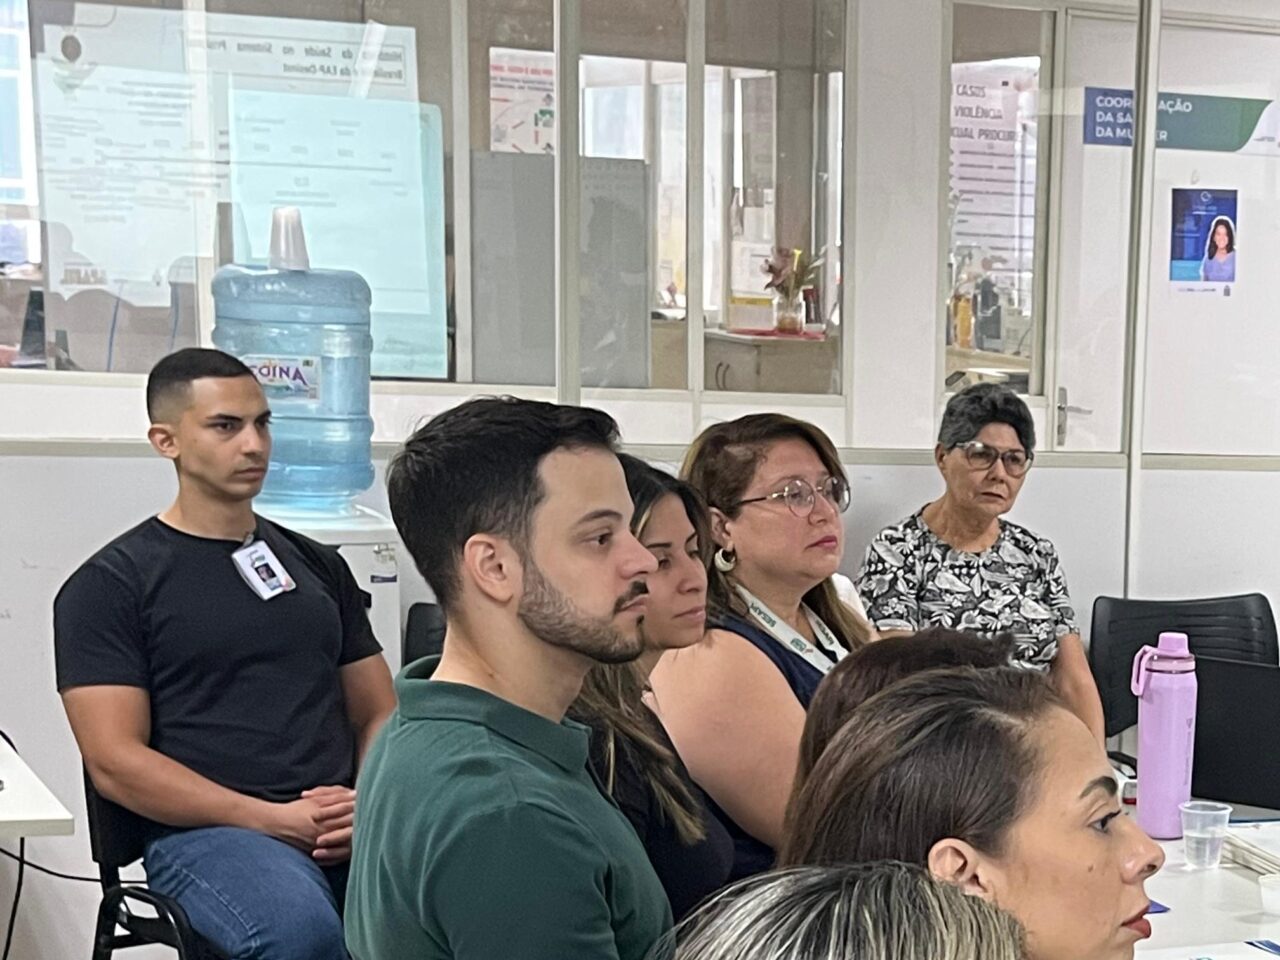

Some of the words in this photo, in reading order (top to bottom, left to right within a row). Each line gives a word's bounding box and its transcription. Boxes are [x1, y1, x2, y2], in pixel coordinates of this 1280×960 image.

[1095, 96, 1193, 114] COORAÇÃO
[1096, 111, 1114, 123] DA
[1095, 127, 1114, 138] DA
